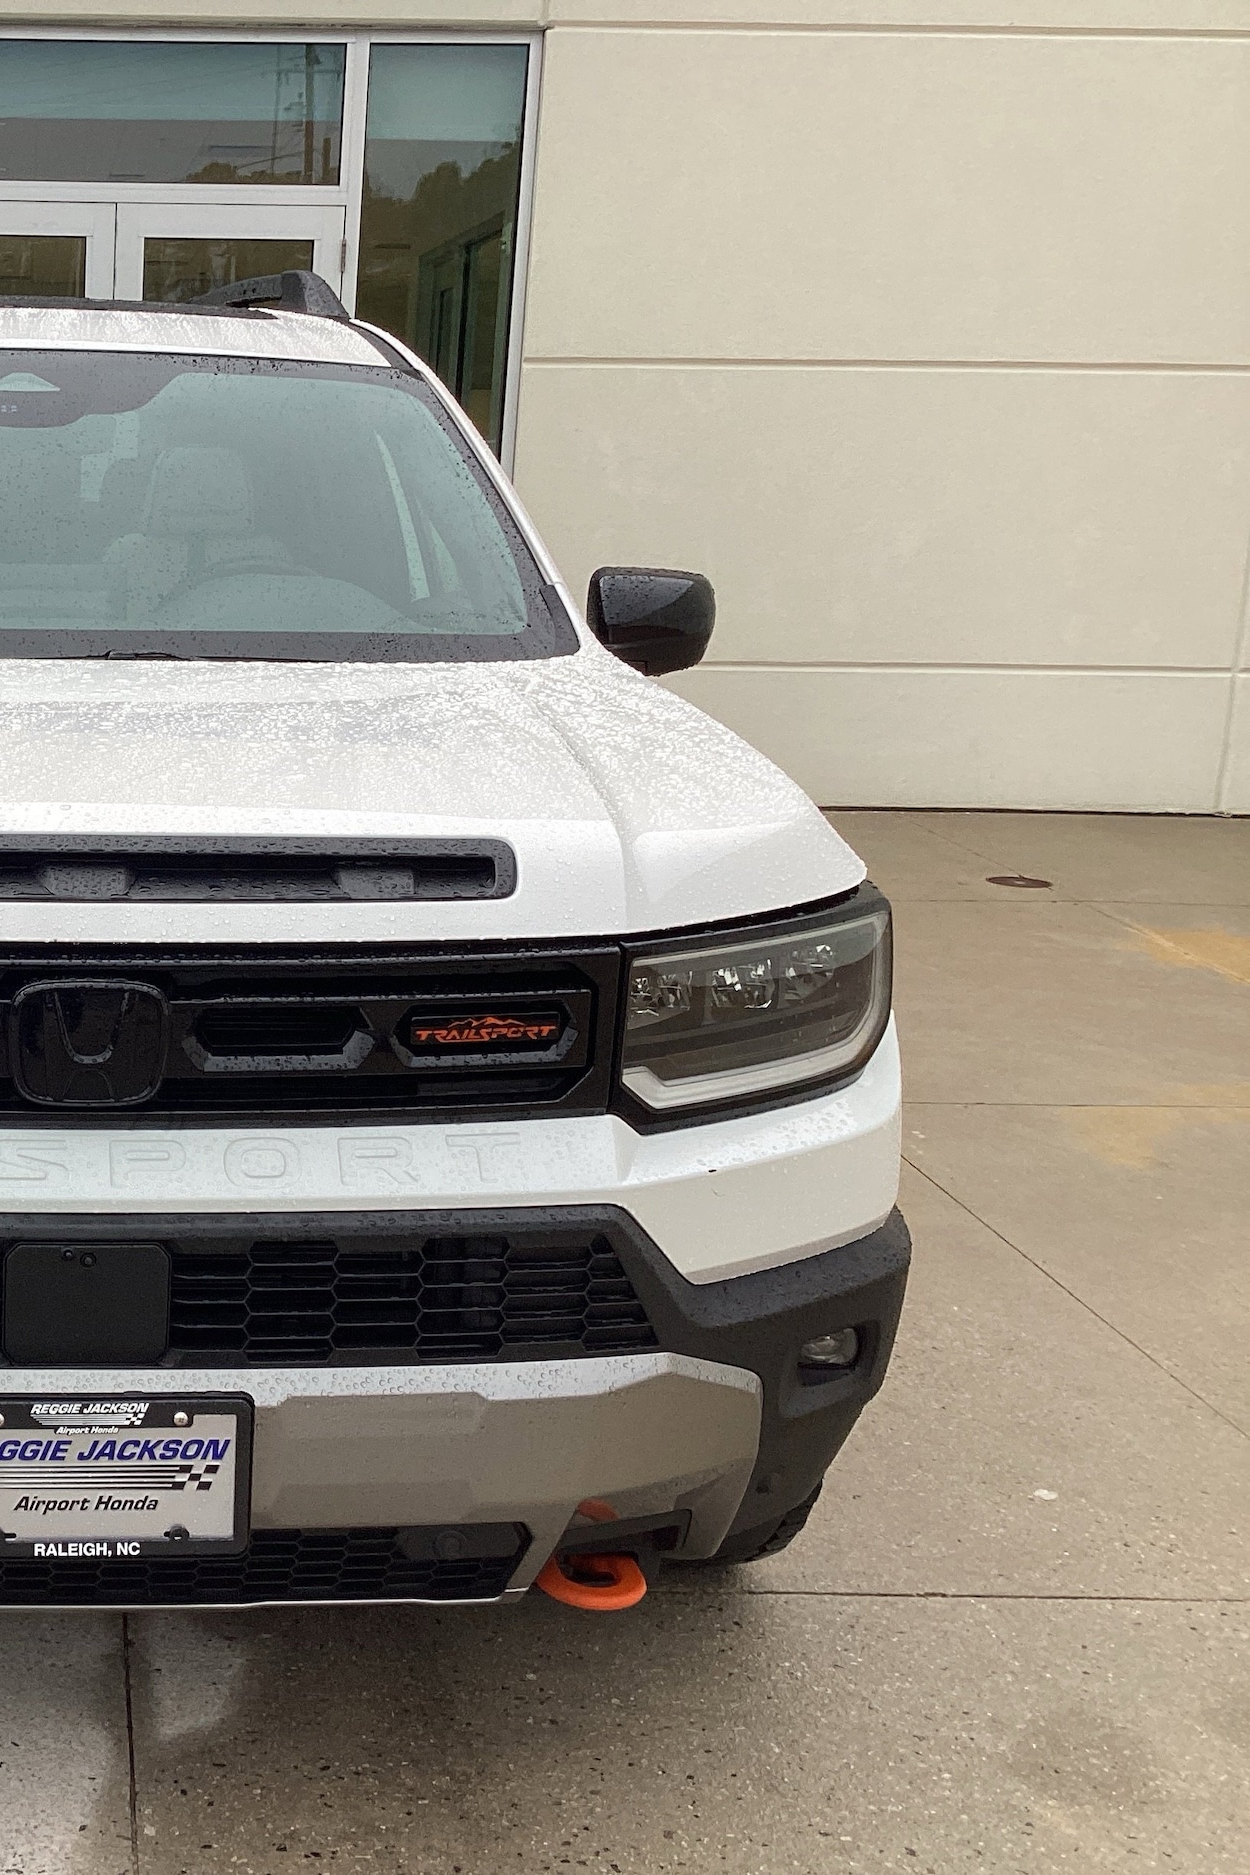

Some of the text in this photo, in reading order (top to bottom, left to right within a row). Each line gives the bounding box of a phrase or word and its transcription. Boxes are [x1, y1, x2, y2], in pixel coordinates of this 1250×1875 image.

[416, 1025, 557, 1043] TRAILSPORT
[30, 1402, 149, 1415] REGGIE JACKSON
[56, 1426, 119, 1436] Airport Honda
[76, 1439, 231, 1461] JACKSON
[14, 1495, 159, 1514] Airport Honda
[34, 1543, 141, 1558] RALEIGH, NC
